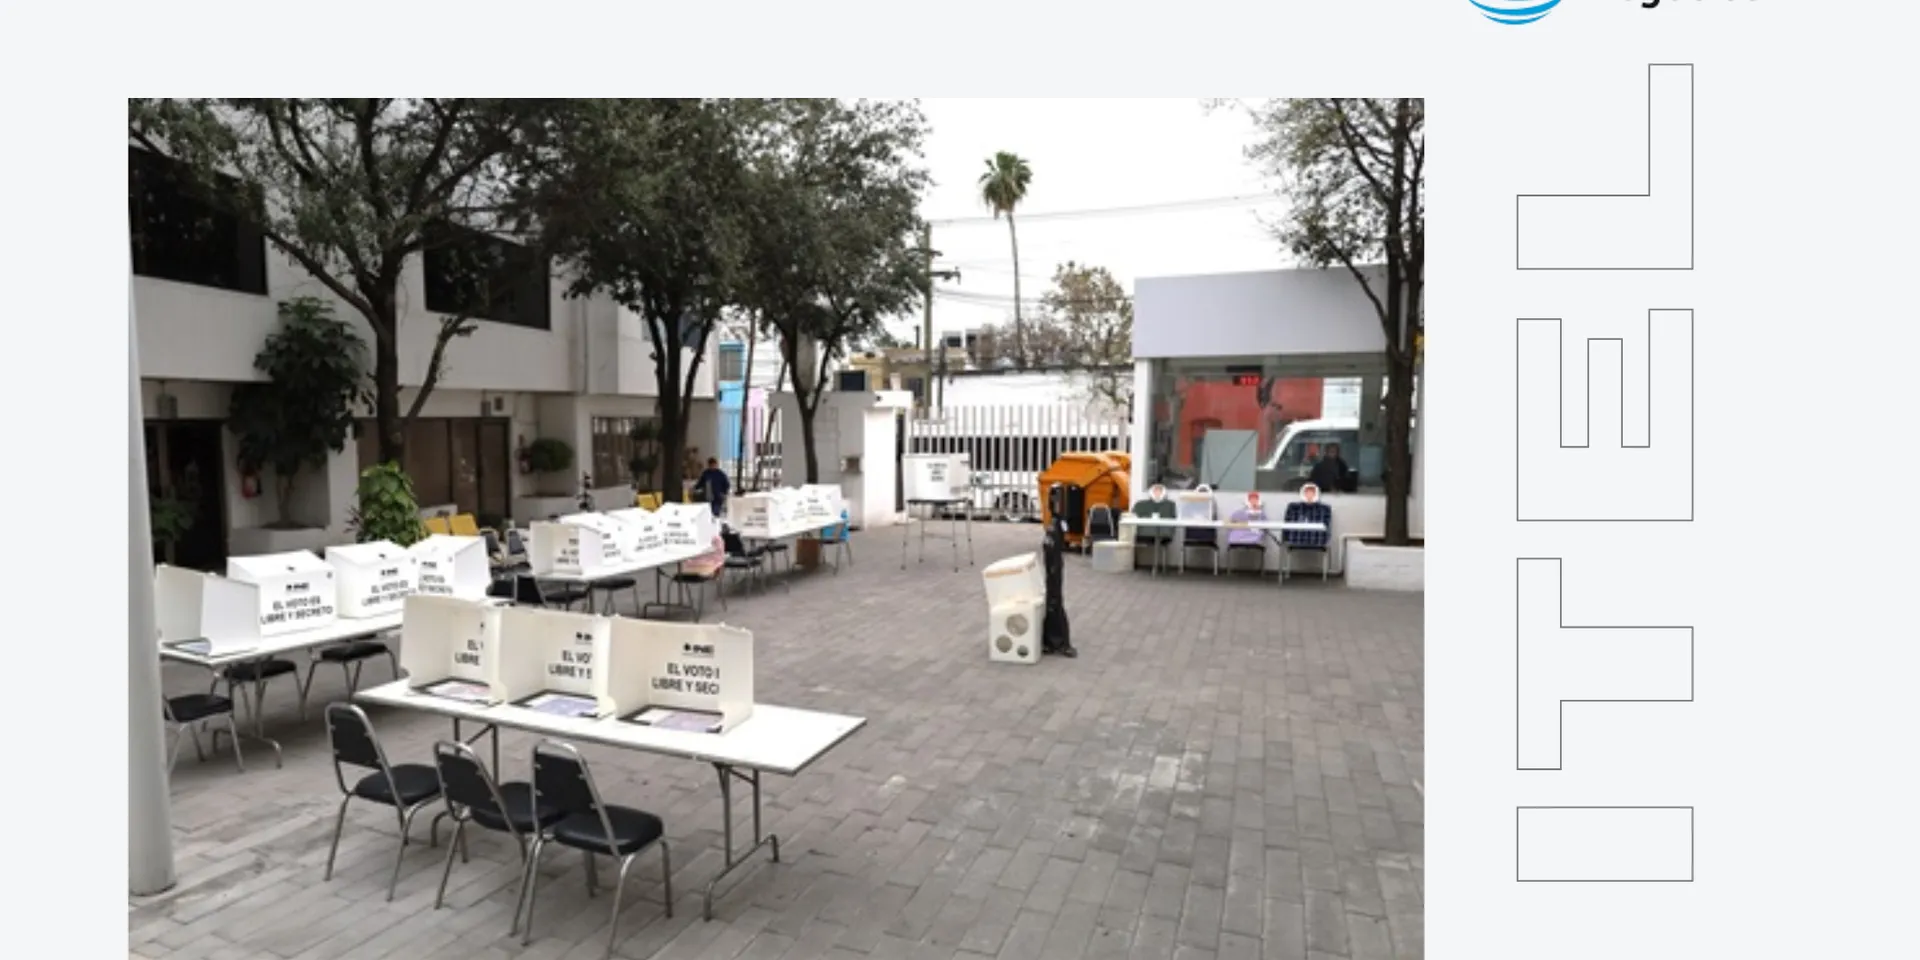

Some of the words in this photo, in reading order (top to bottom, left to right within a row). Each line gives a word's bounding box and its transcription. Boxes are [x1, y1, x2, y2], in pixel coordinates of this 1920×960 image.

[272, 600, 284, 611] EL
[285, 597, 308, 609] VOTO
[259, 612, 286, 625] LIBRE
[295, 604, 333, 620] SECRETO
[467, 639, 479, 651] EL
[454, 651, 480, 667] LIBRE
[562, 649, 575, 663] EL
[547, 663, 576, 678] LIBRE
[667, 662, 681, 676] EL
[683, 664, 712, 679] VOTO
[651, 677, 682, 693] LIBRE
[685, 680, 694, 692] Y
